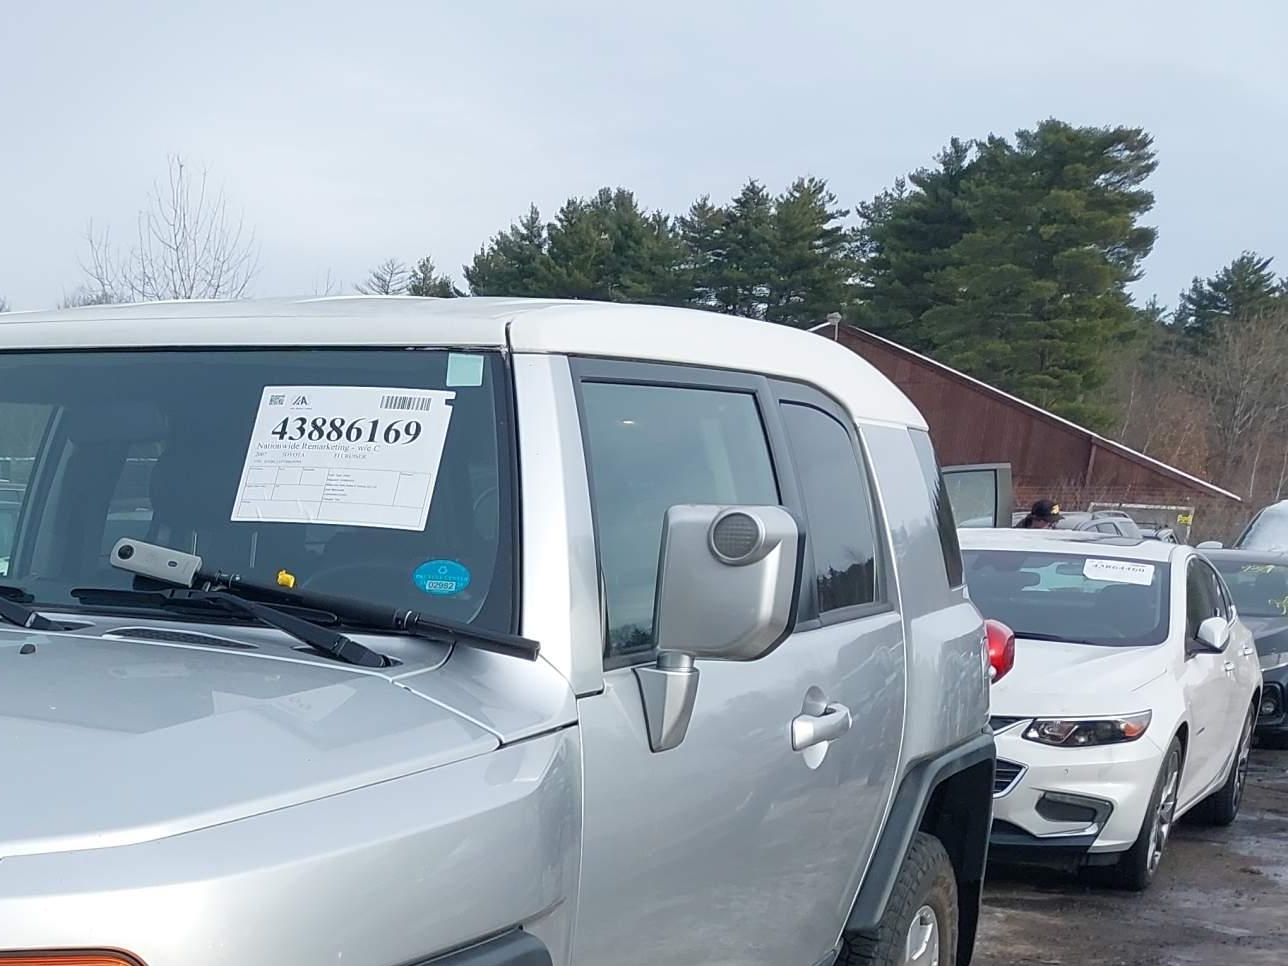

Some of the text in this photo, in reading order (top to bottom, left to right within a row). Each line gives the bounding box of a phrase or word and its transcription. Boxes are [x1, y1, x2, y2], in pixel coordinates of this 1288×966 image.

[271, 416, 422, 445] 43886169
[257, 442, 300, 451] Nationwide
[301, 443, 350, 452] Remarketing
